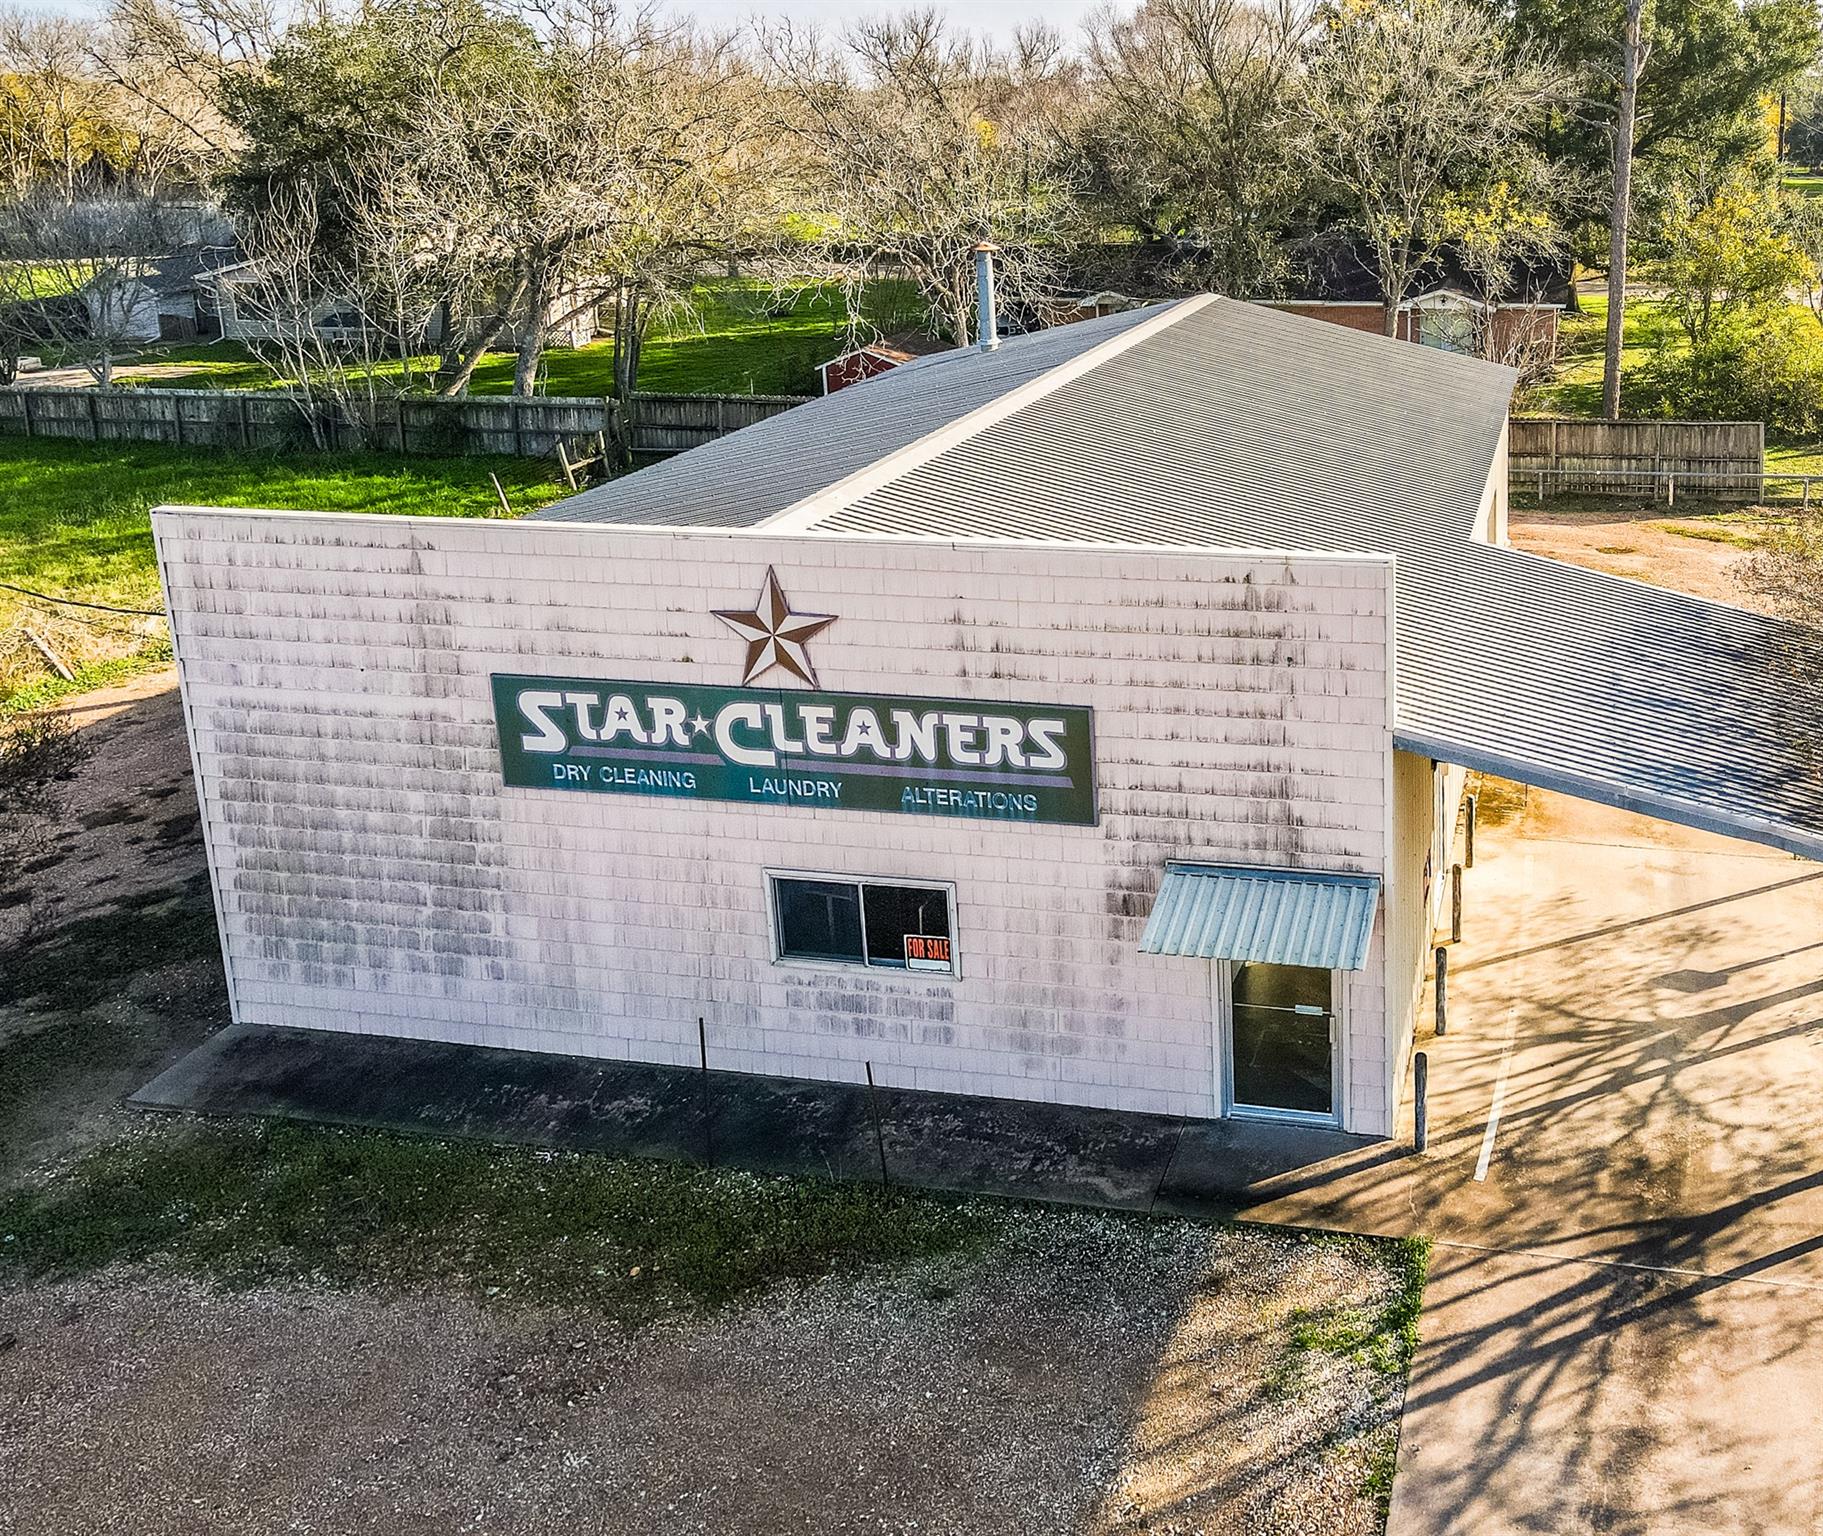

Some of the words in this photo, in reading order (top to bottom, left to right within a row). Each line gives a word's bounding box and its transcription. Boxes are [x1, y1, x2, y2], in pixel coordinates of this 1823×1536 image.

[518, 690, 690, 753] STAR
[714, 703, 1066, 769] CLEANERS
[553, 763, 592, 781] DRY
[599, 766, 697, 789] CLEANING
[749, 777, 843, 799] LAUNDRY
[901, 786, 1038, 812] ALTERATIONS
[907, 938, 925, 958] FOR
[927, 939, 950, 960] SALE
